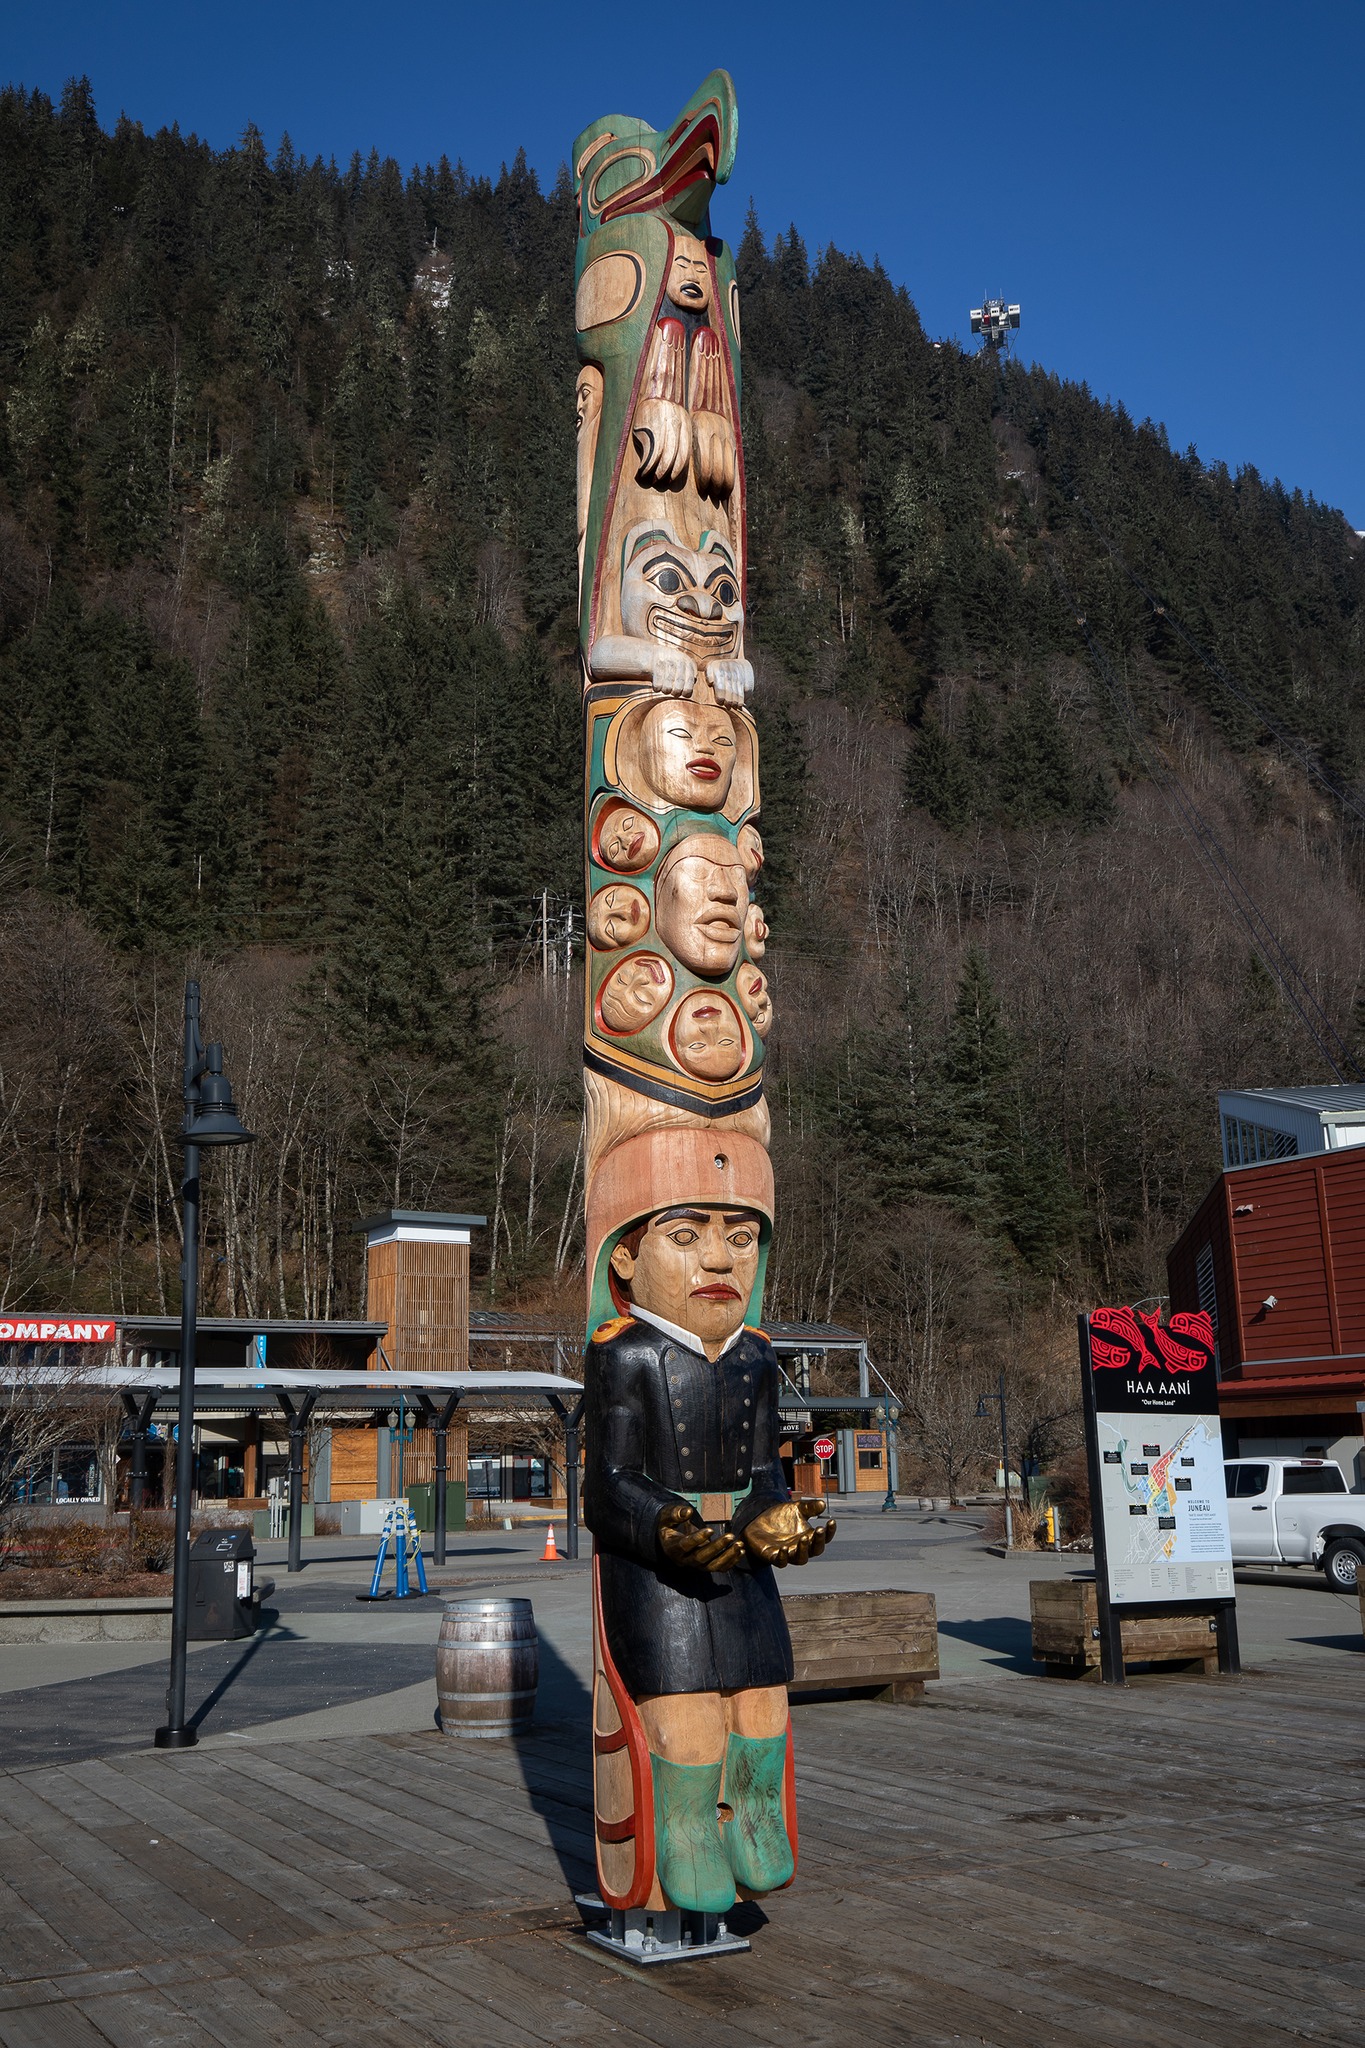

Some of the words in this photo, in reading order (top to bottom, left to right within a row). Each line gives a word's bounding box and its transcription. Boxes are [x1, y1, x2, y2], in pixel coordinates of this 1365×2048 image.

[0, 1323, 111, 1340] OMPANY
[1126, 1380, 1155, 1394] HAA
[1158, 1379, 1191, 1395] AANÍ
[815, 1444, 833, 1454] STOP
[1188, 1504, 1211, 1512] JUNEAU
